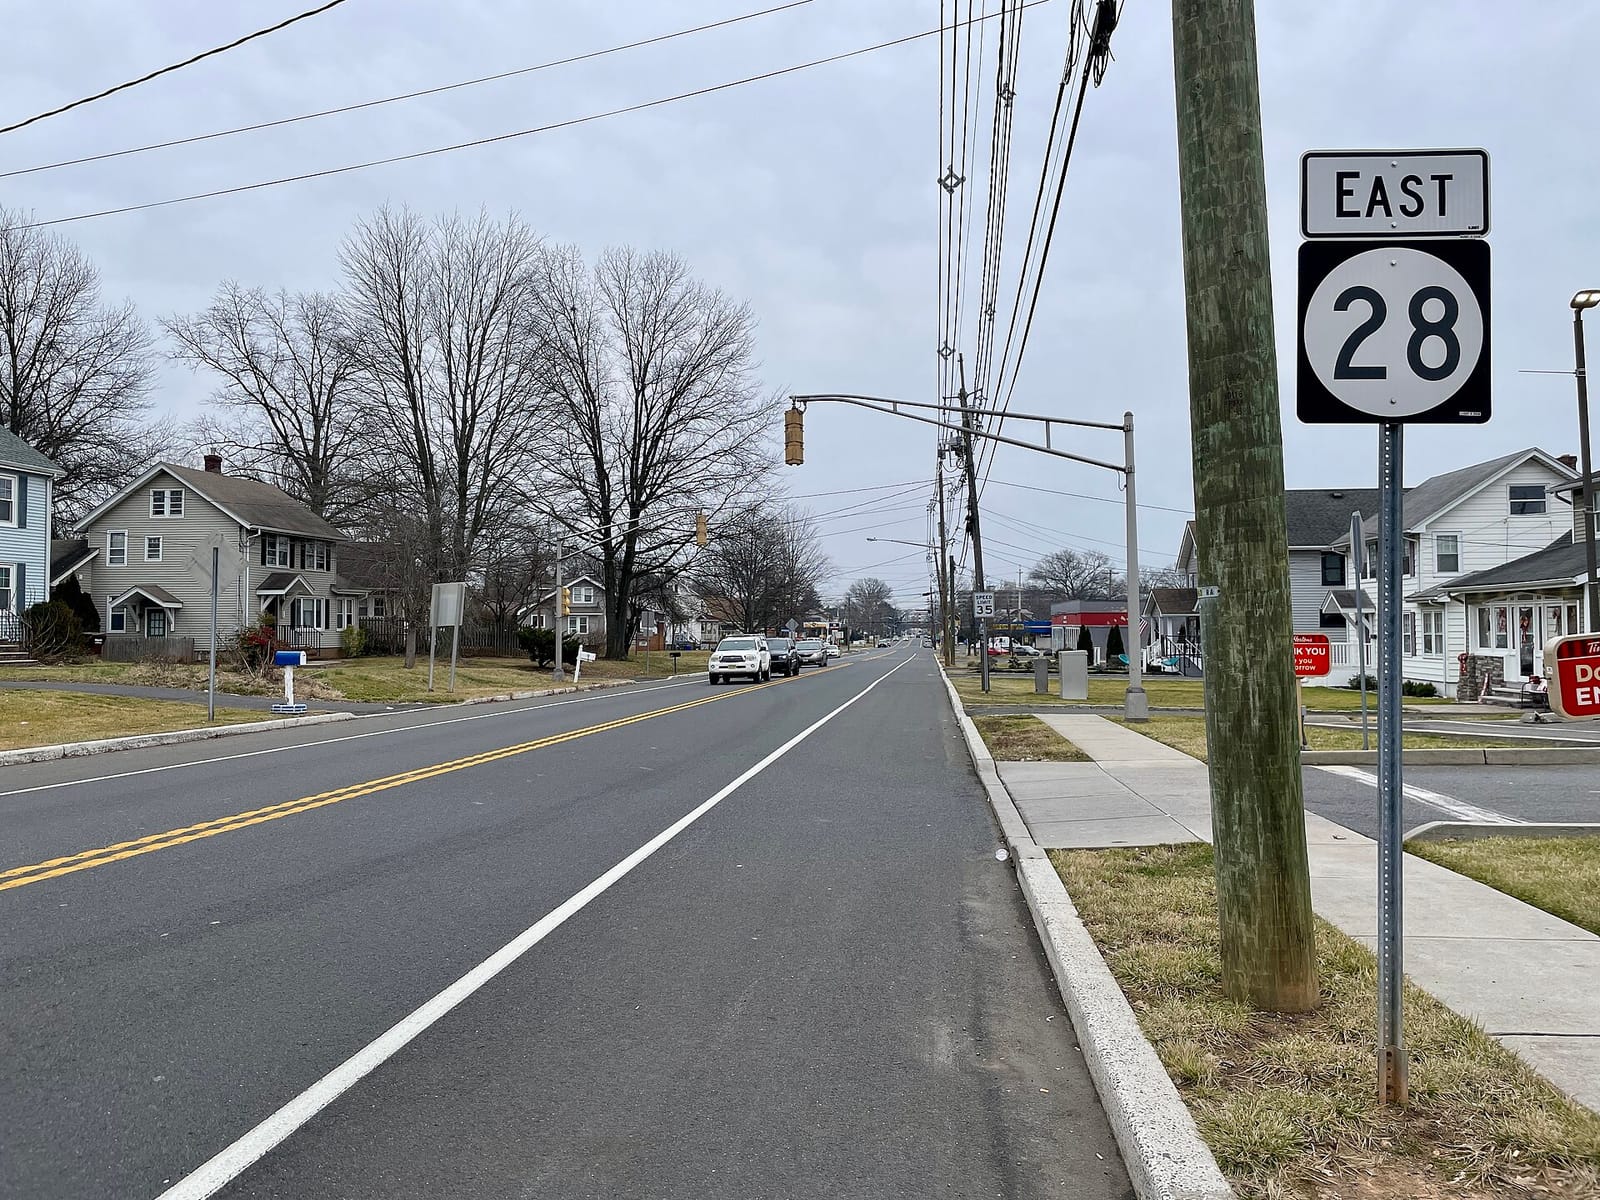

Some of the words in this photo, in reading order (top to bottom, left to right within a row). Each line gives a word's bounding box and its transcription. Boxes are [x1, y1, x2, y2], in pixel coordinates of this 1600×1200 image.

[1335, 171, 1454, 218] EAST
[1333, 285, 1461, 382] 28
[976, 605, 993, 615] 35
[1305, 647, 1326, 656] YOU
